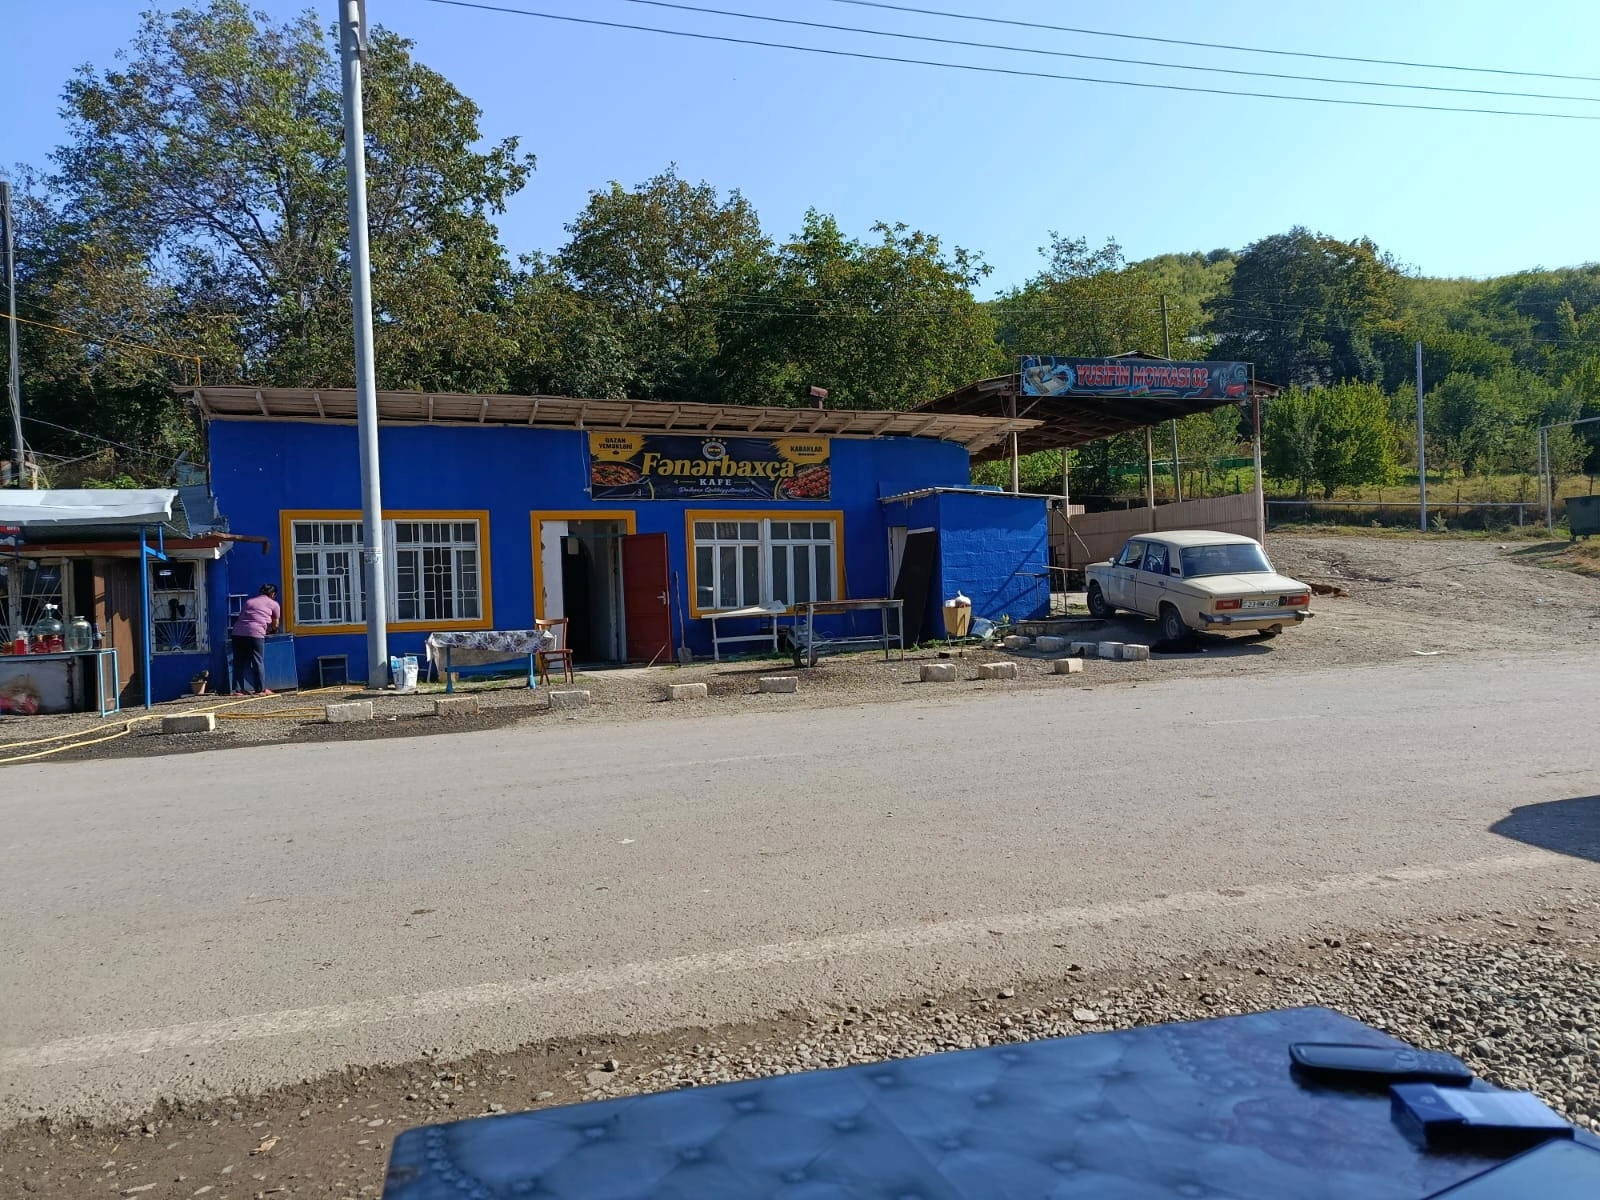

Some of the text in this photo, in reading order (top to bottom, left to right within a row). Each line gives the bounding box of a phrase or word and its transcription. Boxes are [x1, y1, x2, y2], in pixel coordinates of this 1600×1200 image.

[1076, 360, 1131, 387] YUSİFİN
[1133, 366, 1191, 387] MOYKASI
[641, 452, 795, 480] Fənərbaxça
[699, 478, 732, 486] KAFE
